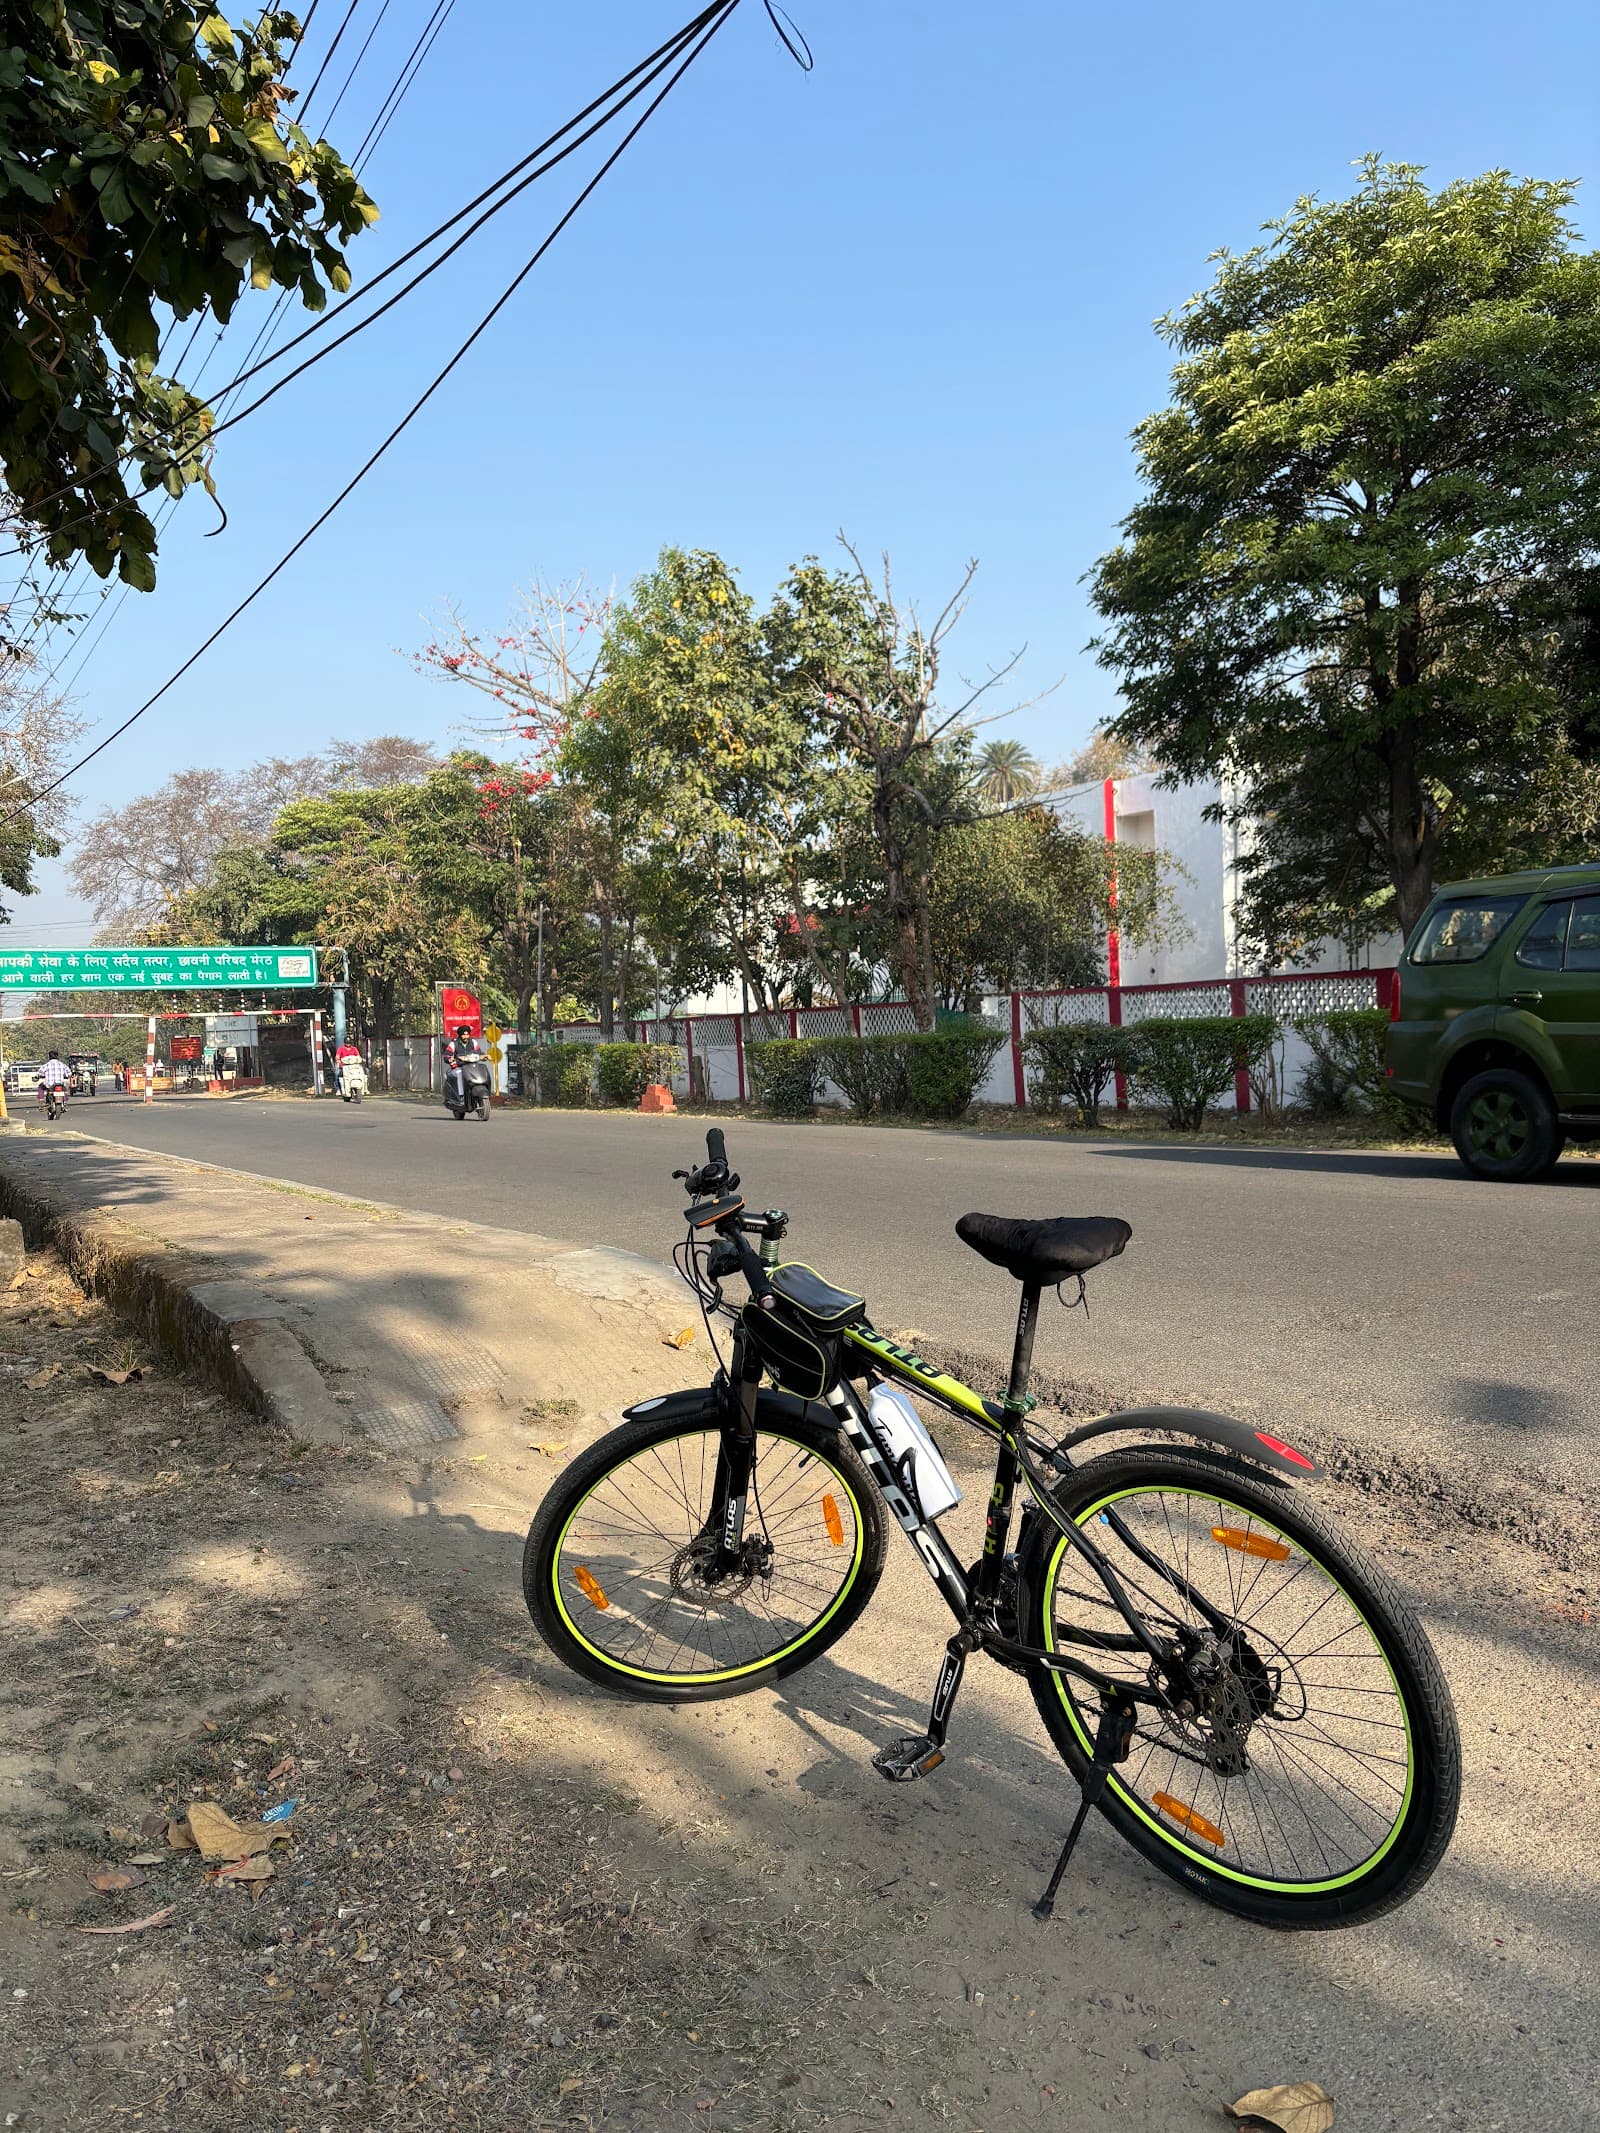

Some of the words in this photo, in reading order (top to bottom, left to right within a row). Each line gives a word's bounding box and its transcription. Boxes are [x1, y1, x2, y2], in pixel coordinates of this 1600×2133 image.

[37, 953, 62, 967] सेवा
[66, 953, 80, 967] के
[84, 954, 109, 970] लिए
[112, 953, 139, 968] सदैव
[177, 953, 210, 966] छावनी
[250, 953, 273, 966] मेरठ
[1, 971, 24, 983] आने
[29, 971, 55, 983] वाली
[60, 974, 75, 984] हर
[79, 974, 102, 983] शाम
[107, 973, 125, 984] एक
[130, 970, 145, 983] नई
[150, 973, 174, 985] सुबह
[178, 973, 193, 981] का
[197, 970, 223, 981] पैगाम
[227, 969, 250, 980] लाती
[1019, 1297, 1029, 1337] ATLAS
[724, 1497, 737, 1550] ATLAS
